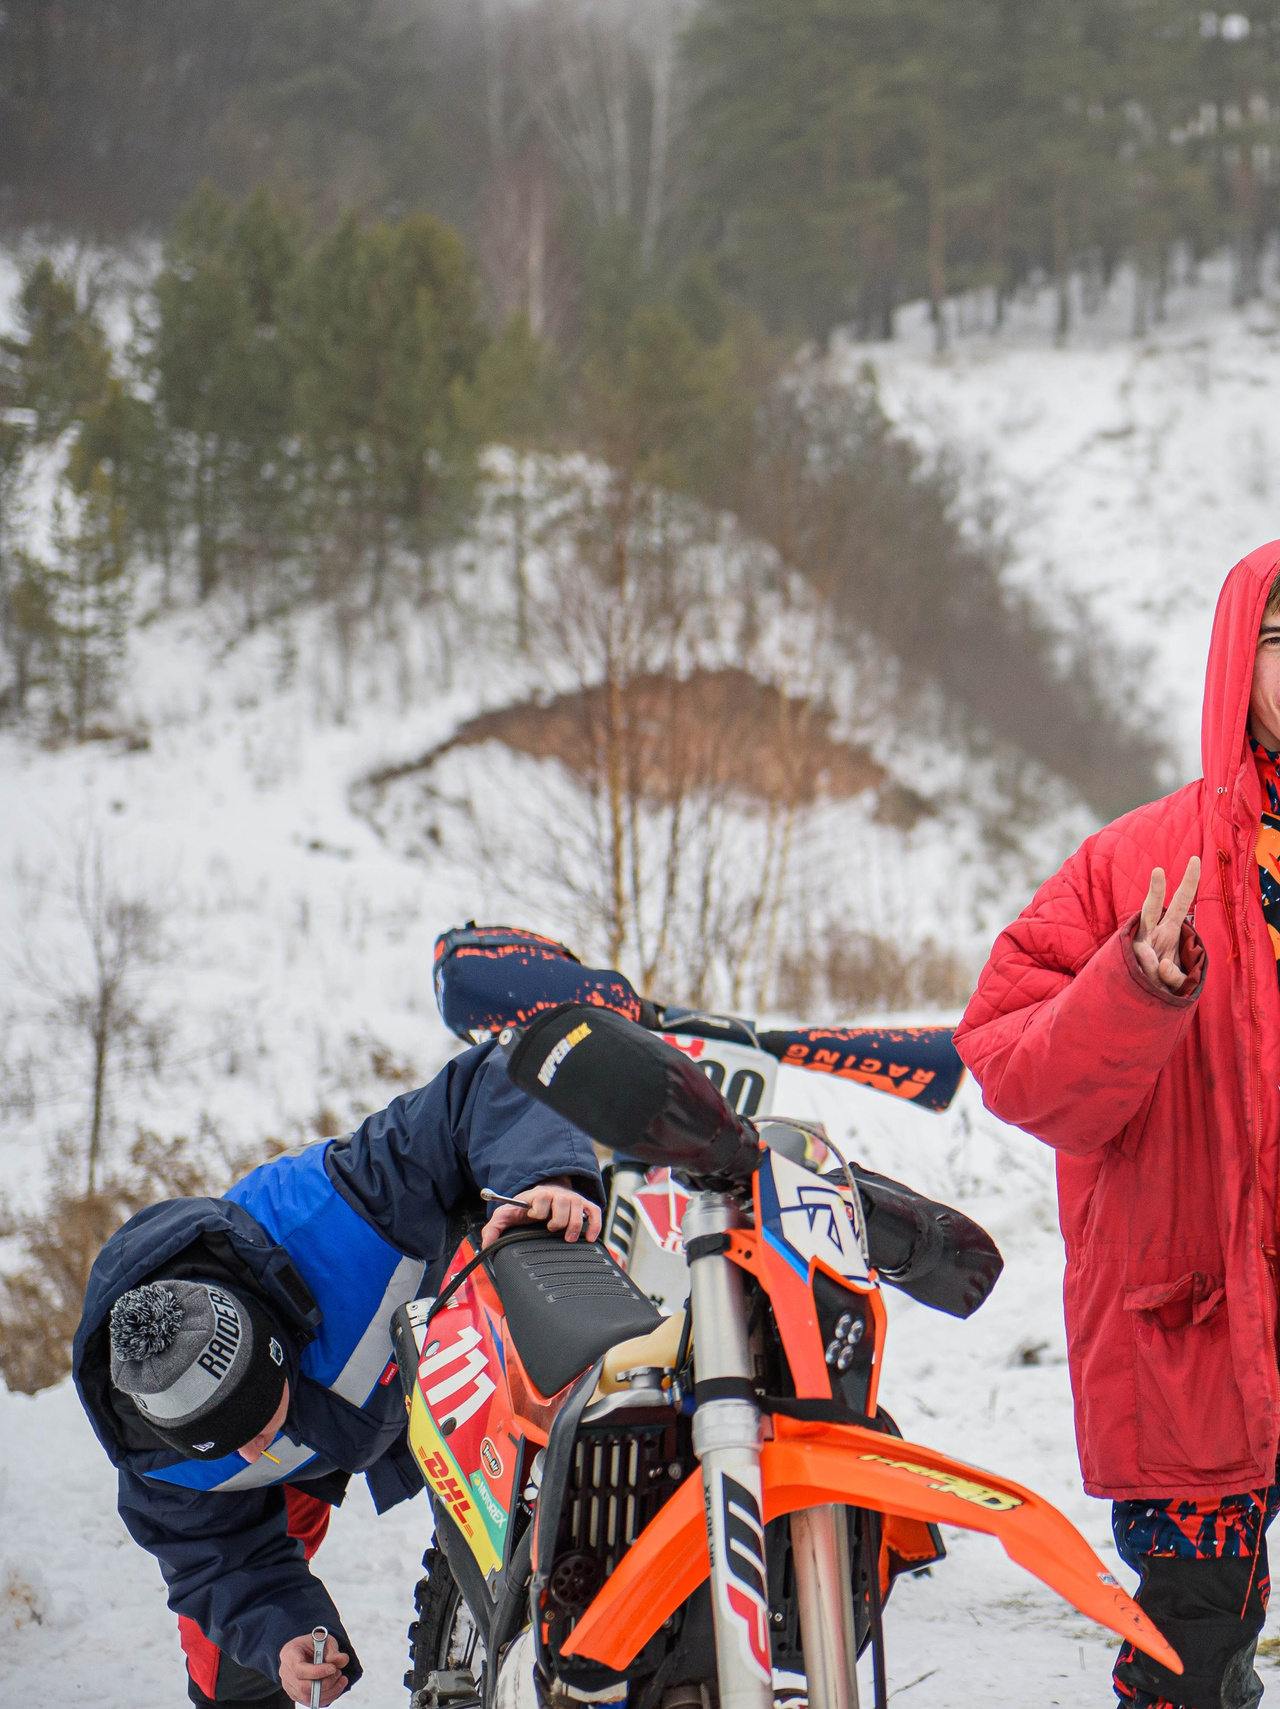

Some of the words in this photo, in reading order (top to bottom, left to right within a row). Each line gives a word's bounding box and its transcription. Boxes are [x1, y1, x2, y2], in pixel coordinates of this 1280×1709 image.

[787, 1043, 936, 1085] RACING
[418, 1325, 498, 1432] 111
[423, 1450, 472, 1525] DHL
[477, 1480, 508, 1529] MOTOREX
